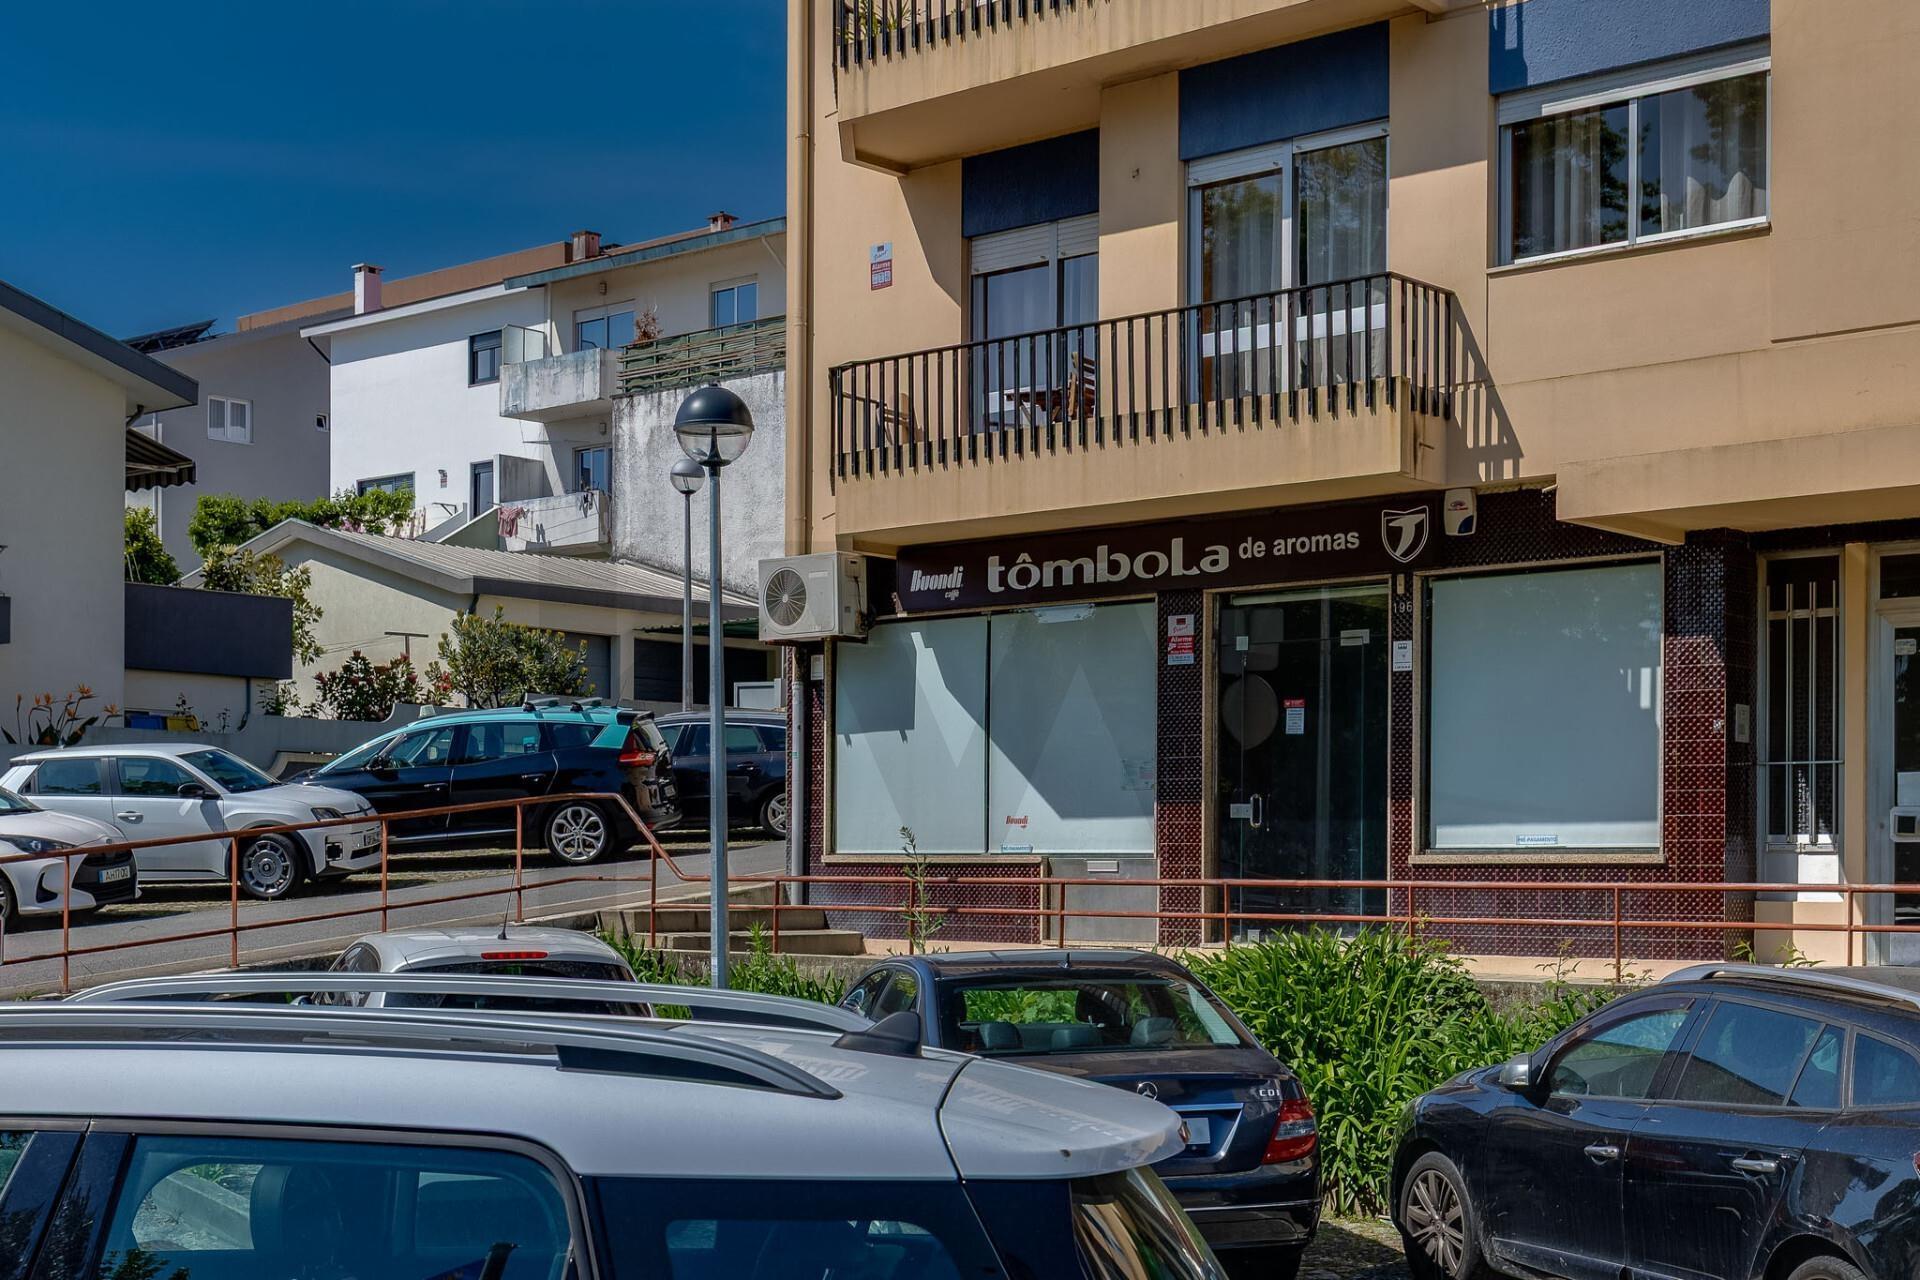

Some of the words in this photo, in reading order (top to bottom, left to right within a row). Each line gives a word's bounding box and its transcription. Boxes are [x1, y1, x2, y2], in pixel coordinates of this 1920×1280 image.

[1239, 536, 1266, 559] de
[1273, 531, 1360, 556] aromas
[910, 565, 964, 593] Buondi
[1393, 601, 1413, 614] 196
[1170, 636, 1193, 644] Alarme
[1259, 1089, 1280, 1097] CDI
